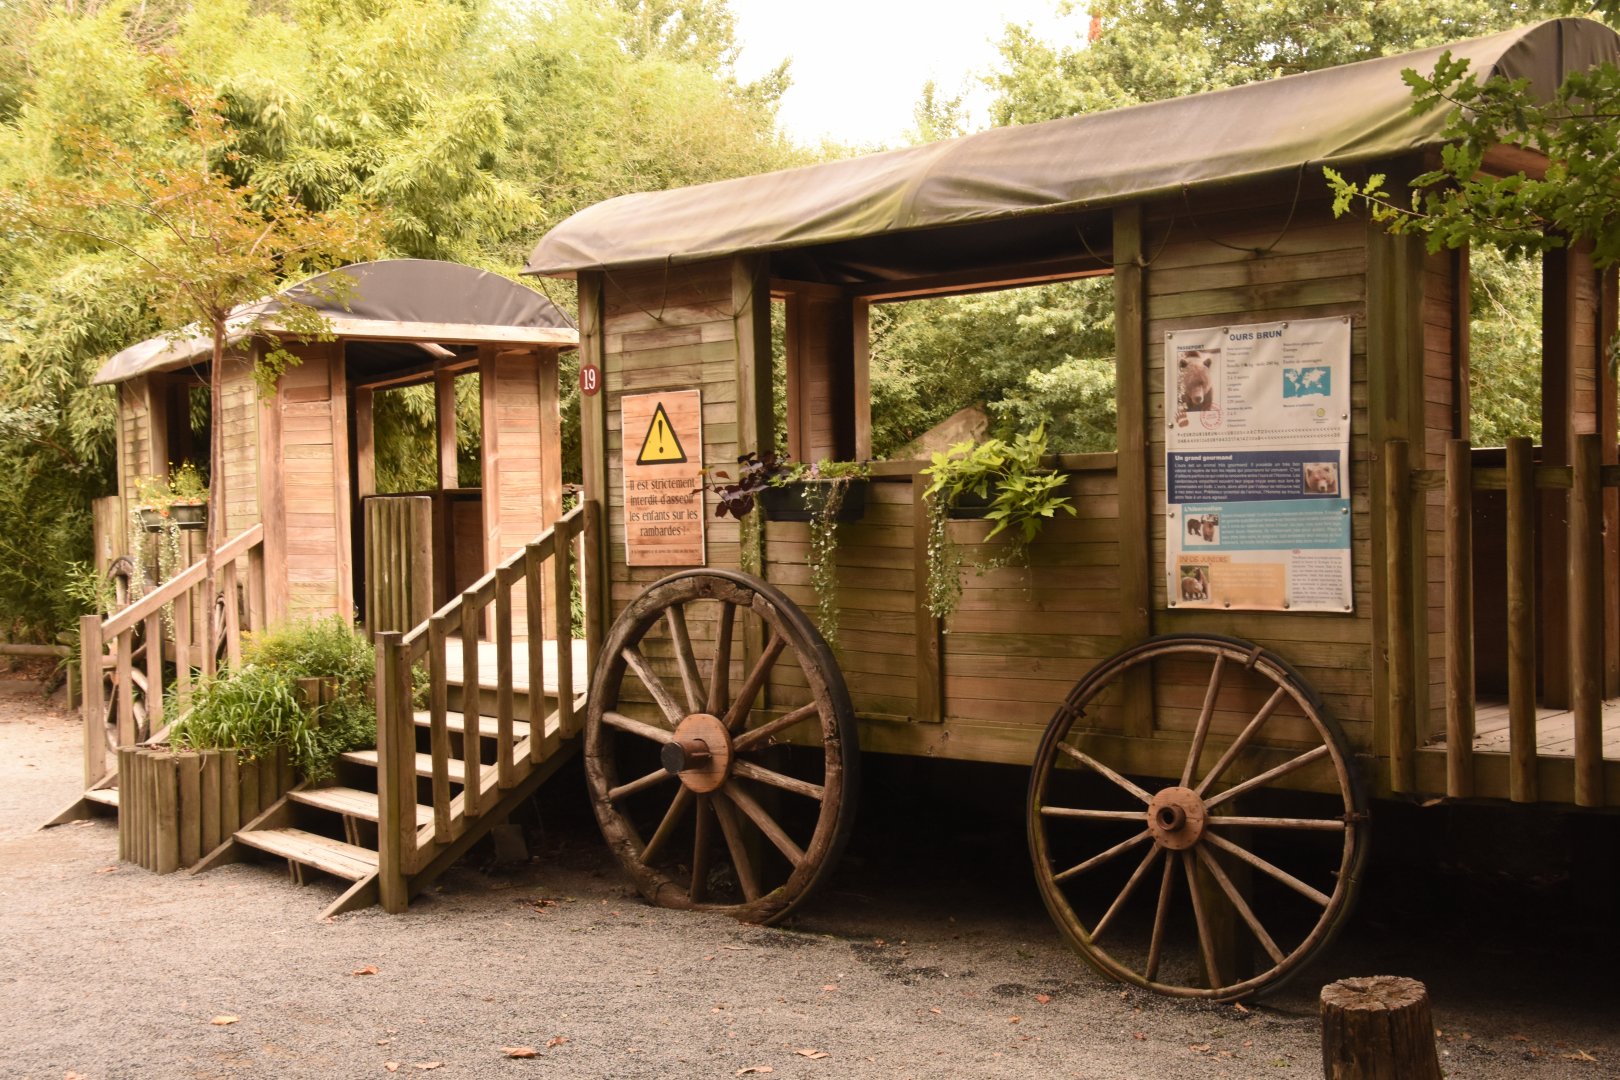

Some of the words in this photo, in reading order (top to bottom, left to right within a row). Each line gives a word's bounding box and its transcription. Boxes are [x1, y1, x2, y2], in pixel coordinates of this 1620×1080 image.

[1229, 333, 1254, 341] OURS
[1256, 330, 1282, 339] BRUN
[583, 368, 596, 390] 19
[1202, 454, 1233, 462] gourmand
[629, 480, 635, 491] Il
[637, 481, 648, 490] est
[651, 478, 695, 490] strictement
[630, 494, 658, 506] interdit
[661, 493, 694, 505] d'asseoir
[629, 511, 640, 522] les
[642, 510, 670, 521] enfants
[672, 511, 686, 520] sur
[687, 508, 698, 520] les
[640, 525, 681, 537] rambardes
